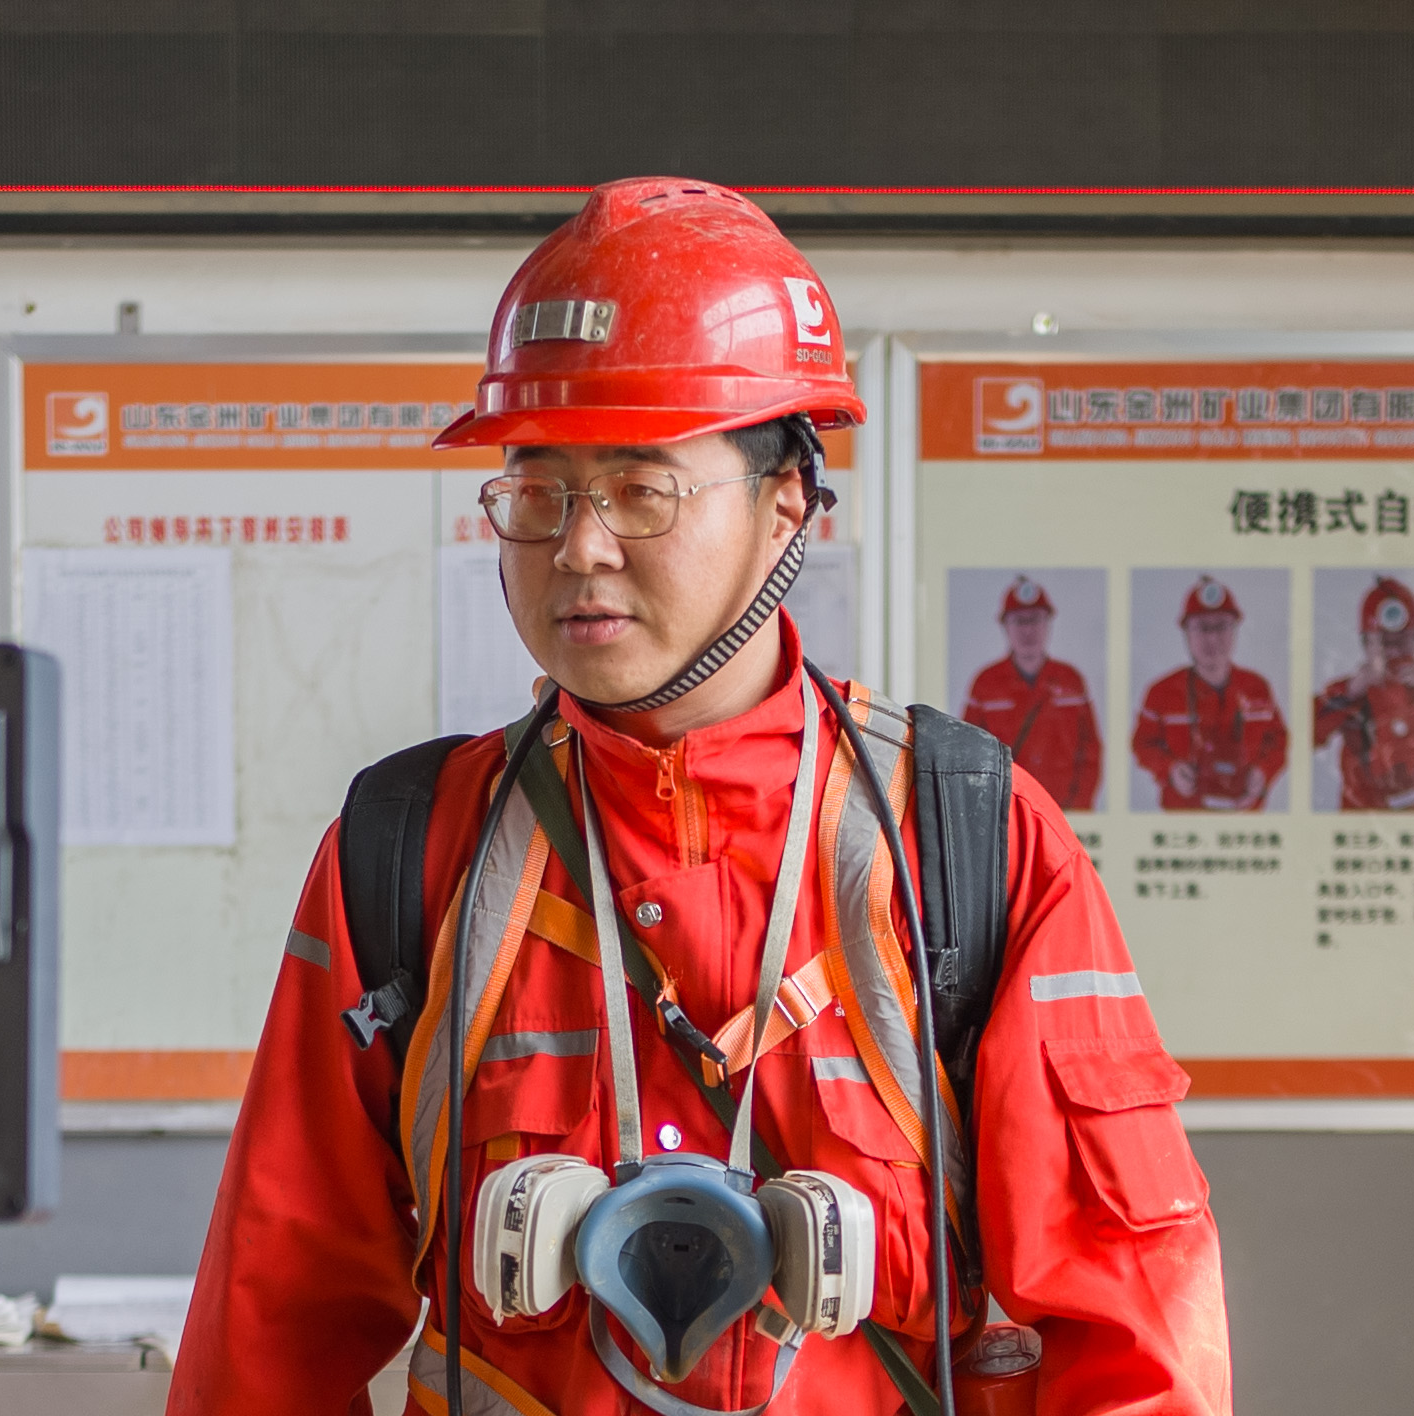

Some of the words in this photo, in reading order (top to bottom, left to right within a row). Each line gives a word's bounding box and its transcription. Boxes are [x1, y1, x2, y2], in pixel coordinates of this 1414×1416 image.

[796, 348, 833, 366] SD-GOLD
[121, 403, 485, 431] 山东金洲矿业集团有限公
